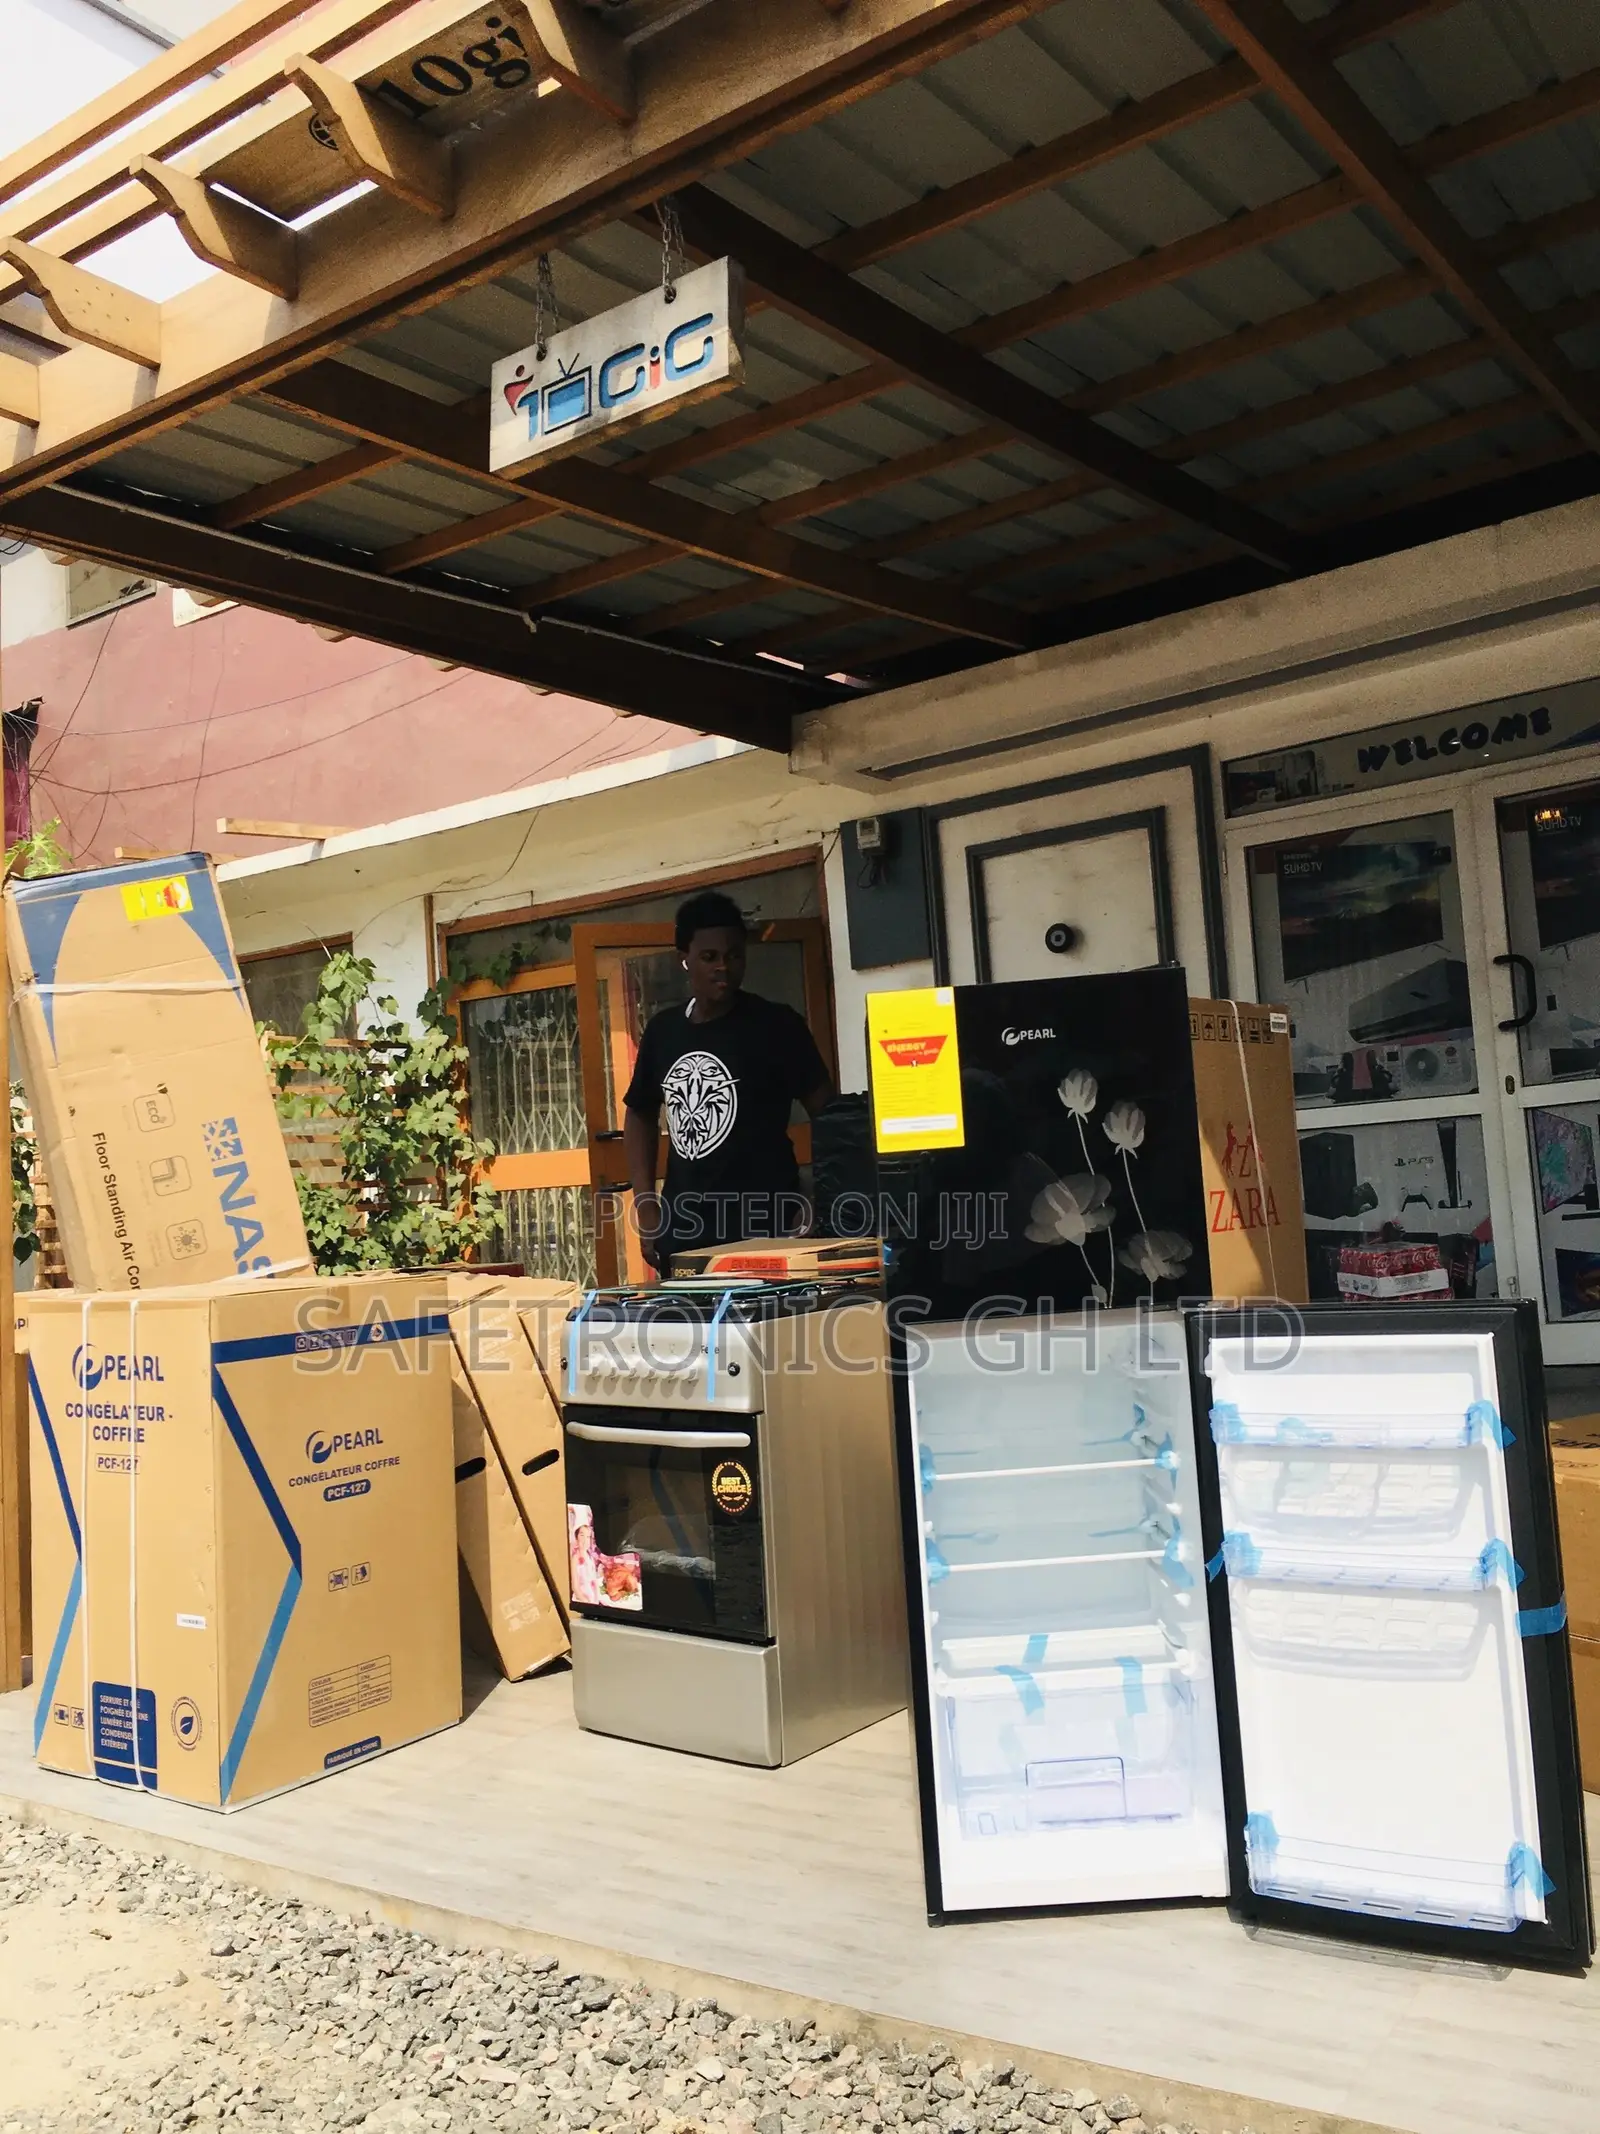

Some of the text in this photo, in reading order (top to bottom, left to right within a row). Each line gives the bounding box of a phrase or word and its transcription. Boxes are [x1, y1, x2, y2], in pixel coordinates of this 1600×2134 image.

[1357, 706, 1552, 774] WELCOME
[1020, 1028, 1057, 1041] PEARL
[145, 1100, 161, 1124] ECO
[92, 1132, 111, 1170] Floor
[104, 1174, 128, 1239] Standing
[120, 1241, 135, 1262] Air
[1208, 1185, 1281, 1233] ZARA
[104, 1355, 165, 1382] PEARL
[333, 1428, 385, 1454] PEARL
[288, 1455, 401, 1488] CONGÉLATEUR COFFRE
[721, 1476, 741, 1485] BEST
[327, 1481, 368, 1499] PCF-127
[717, 1484, 747, 1493] CHOICE
